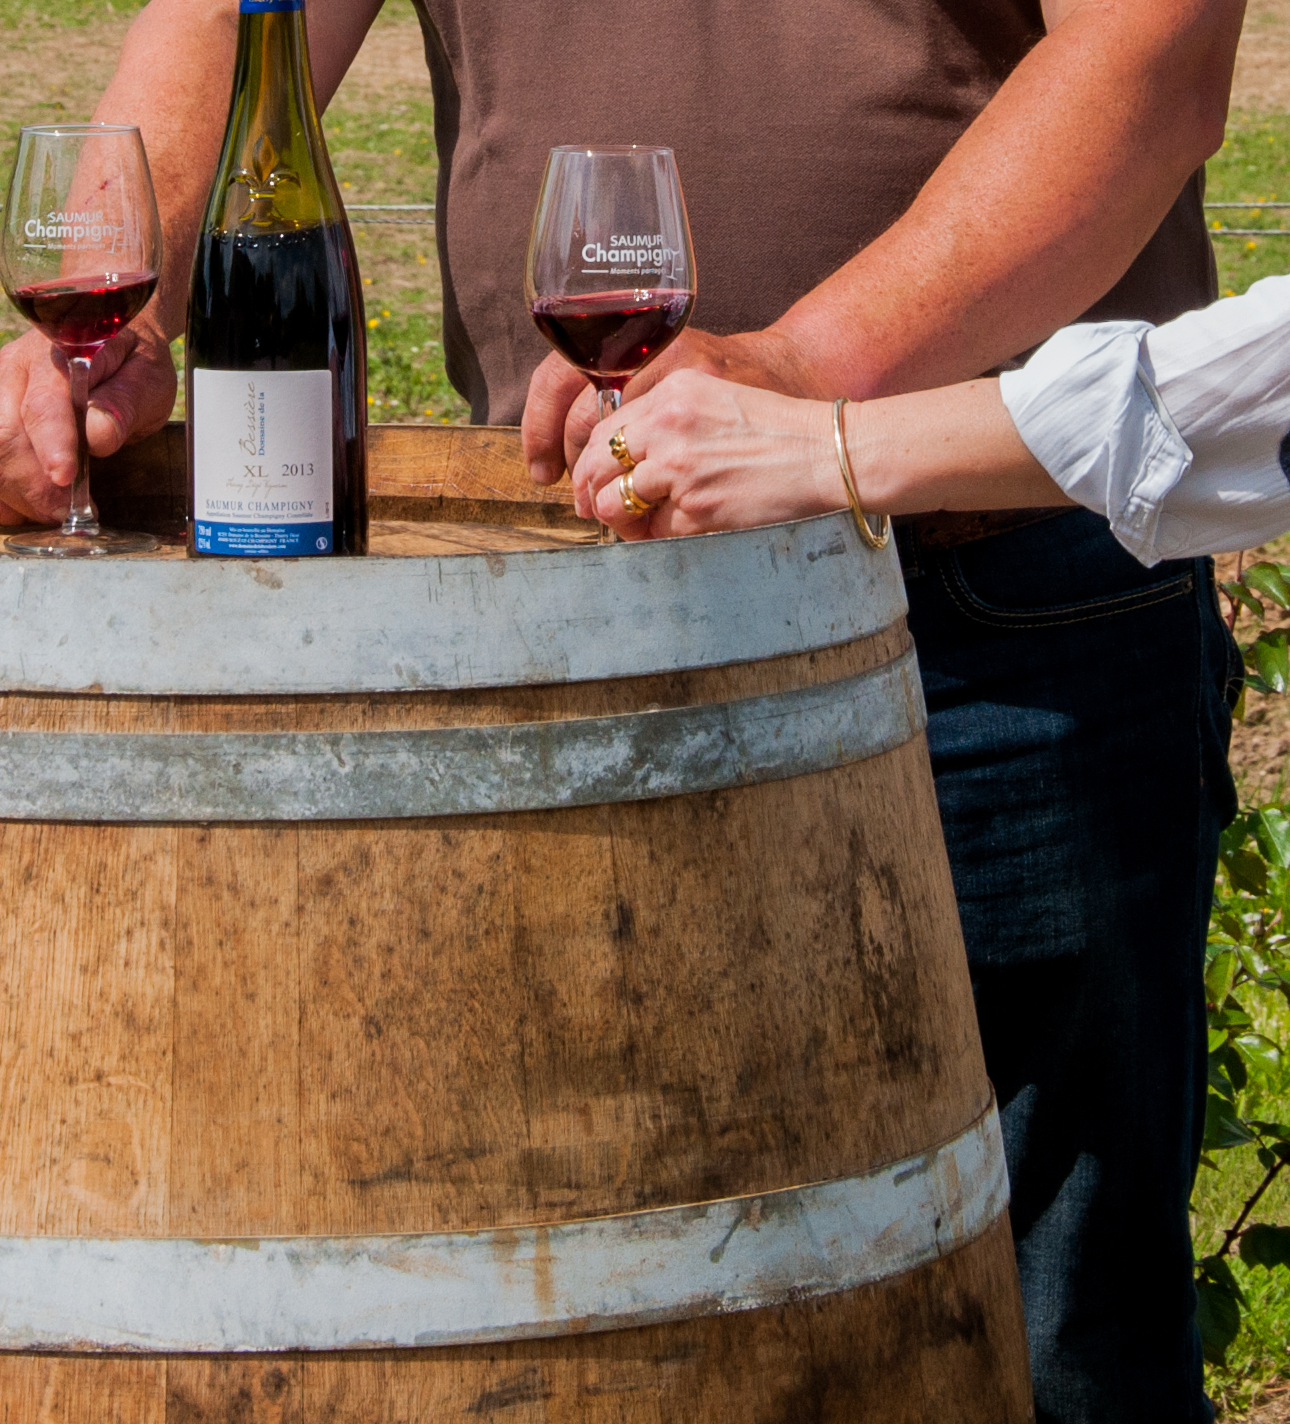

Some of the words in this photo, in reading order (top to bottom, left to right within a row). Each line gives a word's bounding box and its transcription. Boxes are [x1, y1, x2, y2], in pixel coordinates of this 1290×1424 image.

[47, 210, 104, 224] SAUMUR
[610, 234, 664, 247] SAUMUR
[258, 392, 265, 400] la
[258, 402, 265, 414] de
[243, 465, 269, 478] XL
[281, 463, 314, 477] 2013
[206, 499, 243, 511] SAUMUR
[247, 500, 314, 512] CHAMPIGNY
